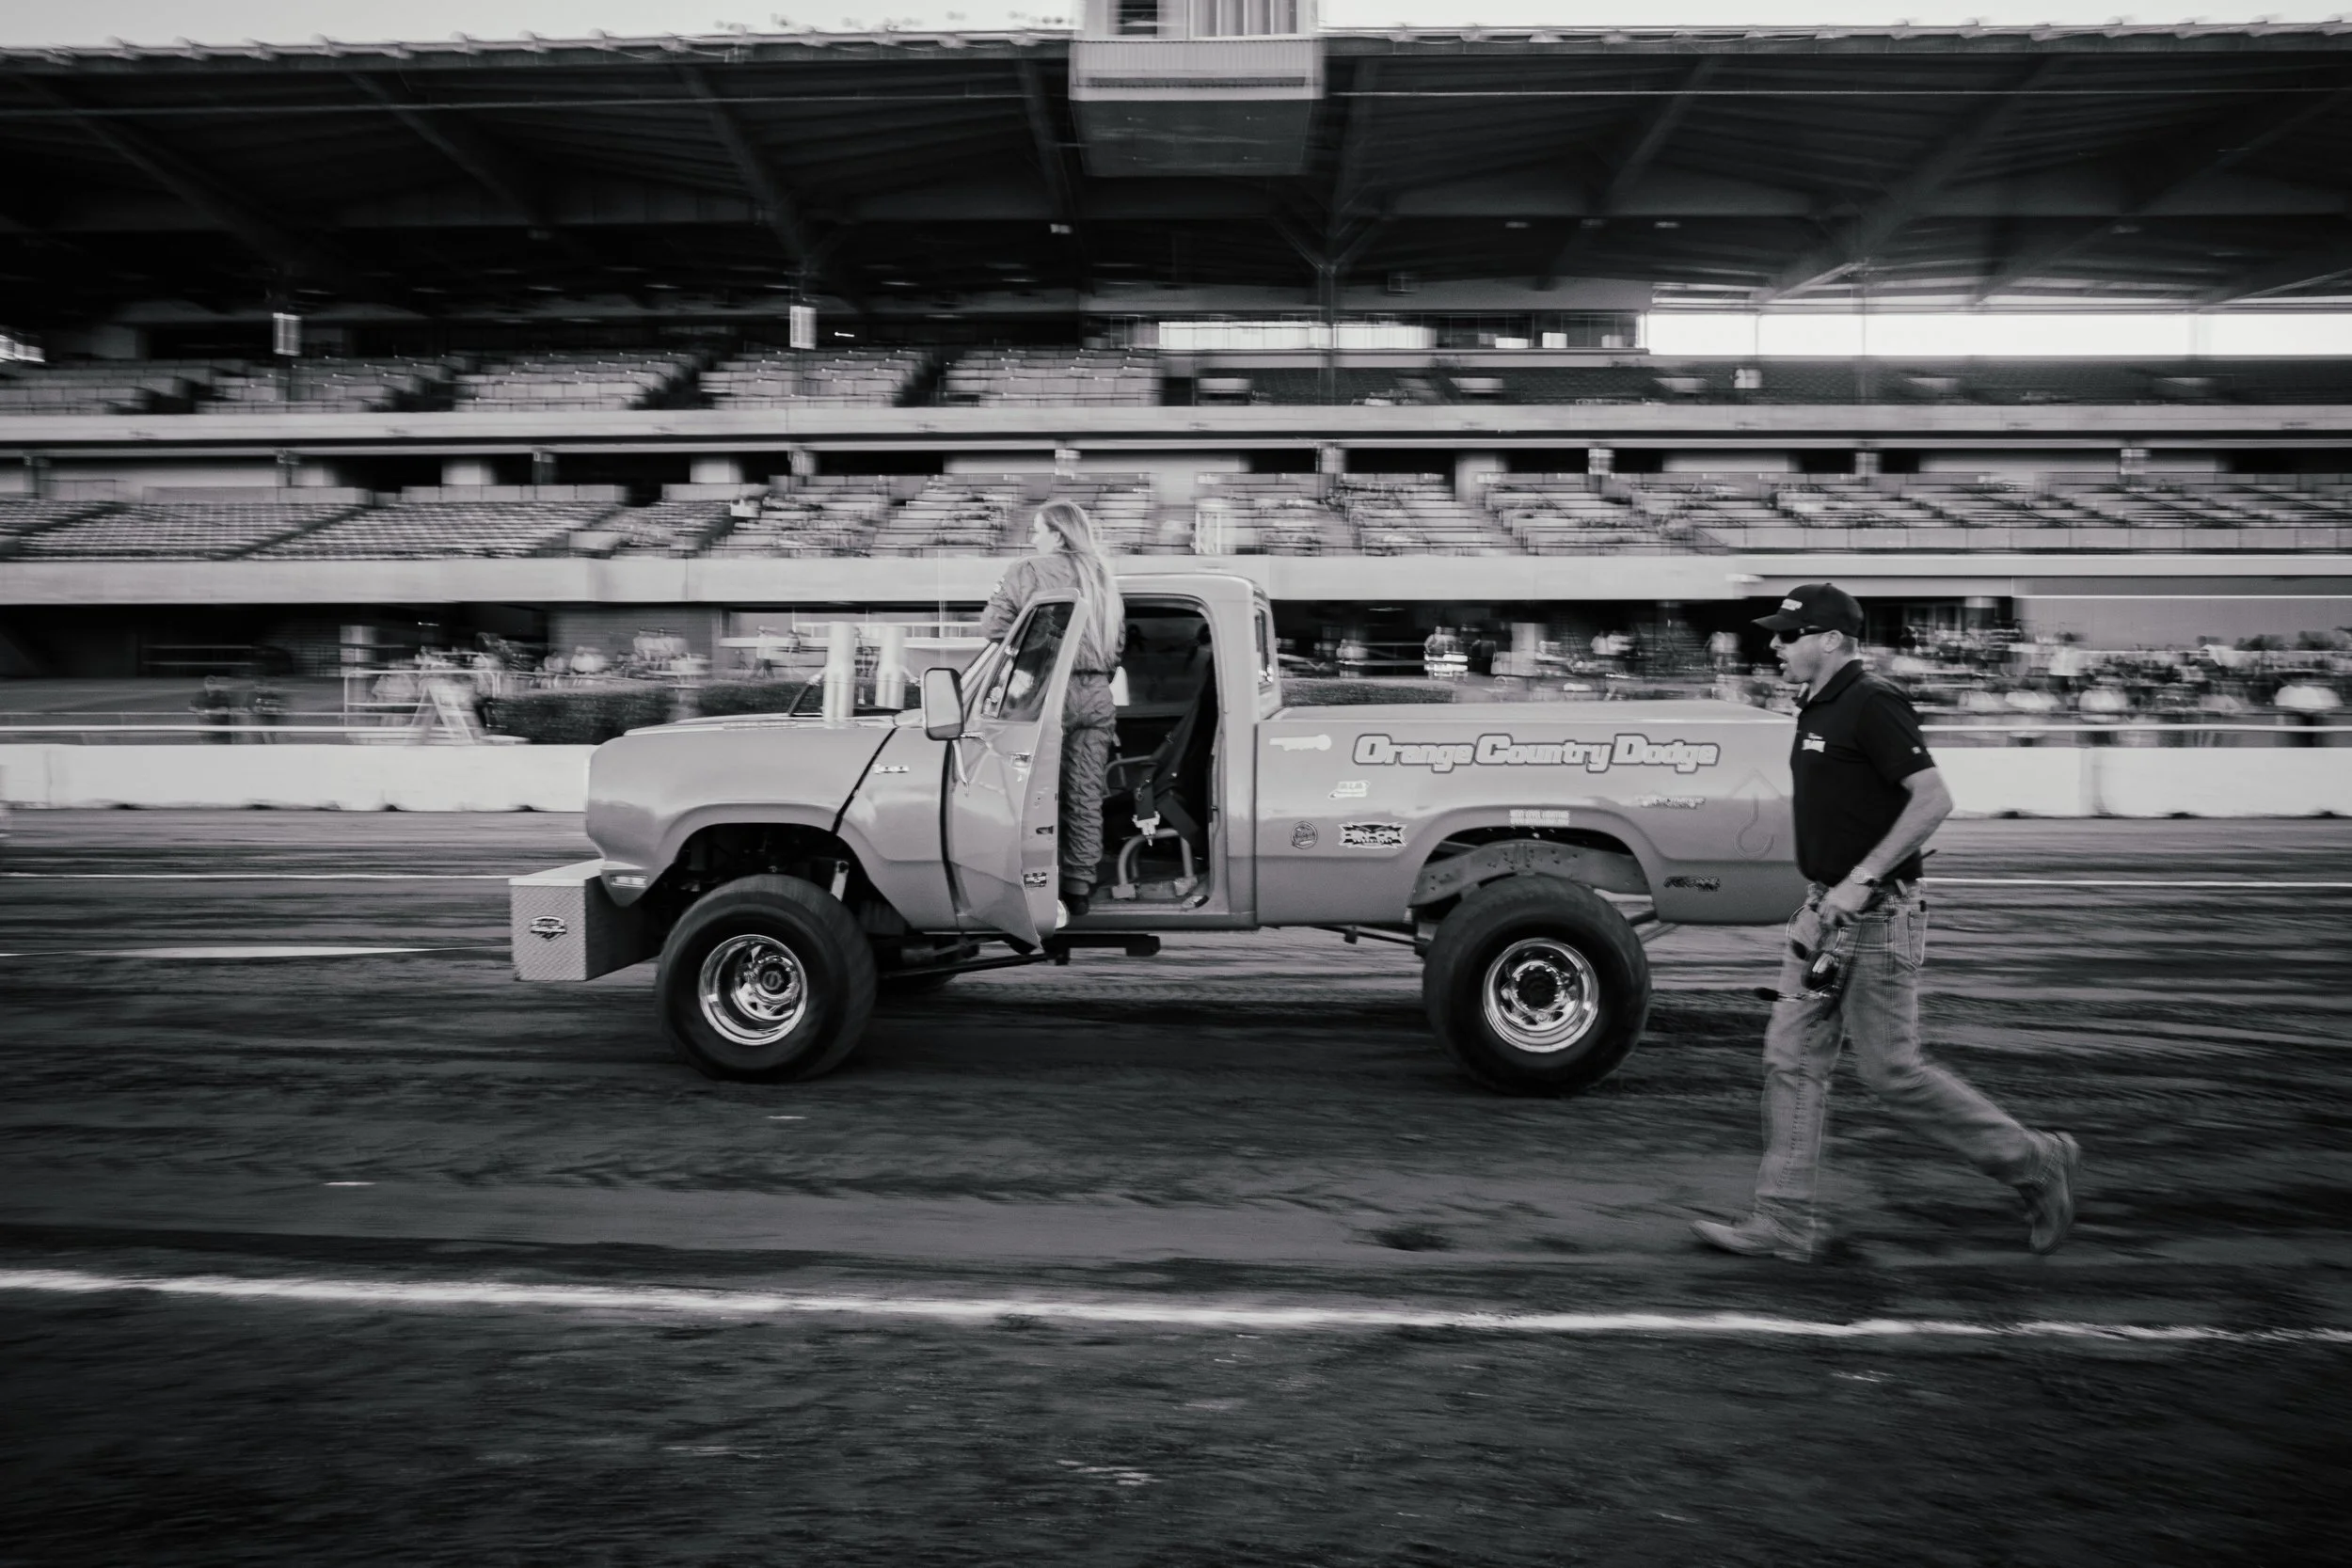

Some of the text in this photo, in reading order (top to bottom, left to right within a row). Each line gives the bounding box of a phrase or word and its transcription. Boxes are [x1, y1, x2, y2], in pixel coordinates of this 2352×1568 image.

[1354, 734, 1720, 773] Orange Country Dodge
